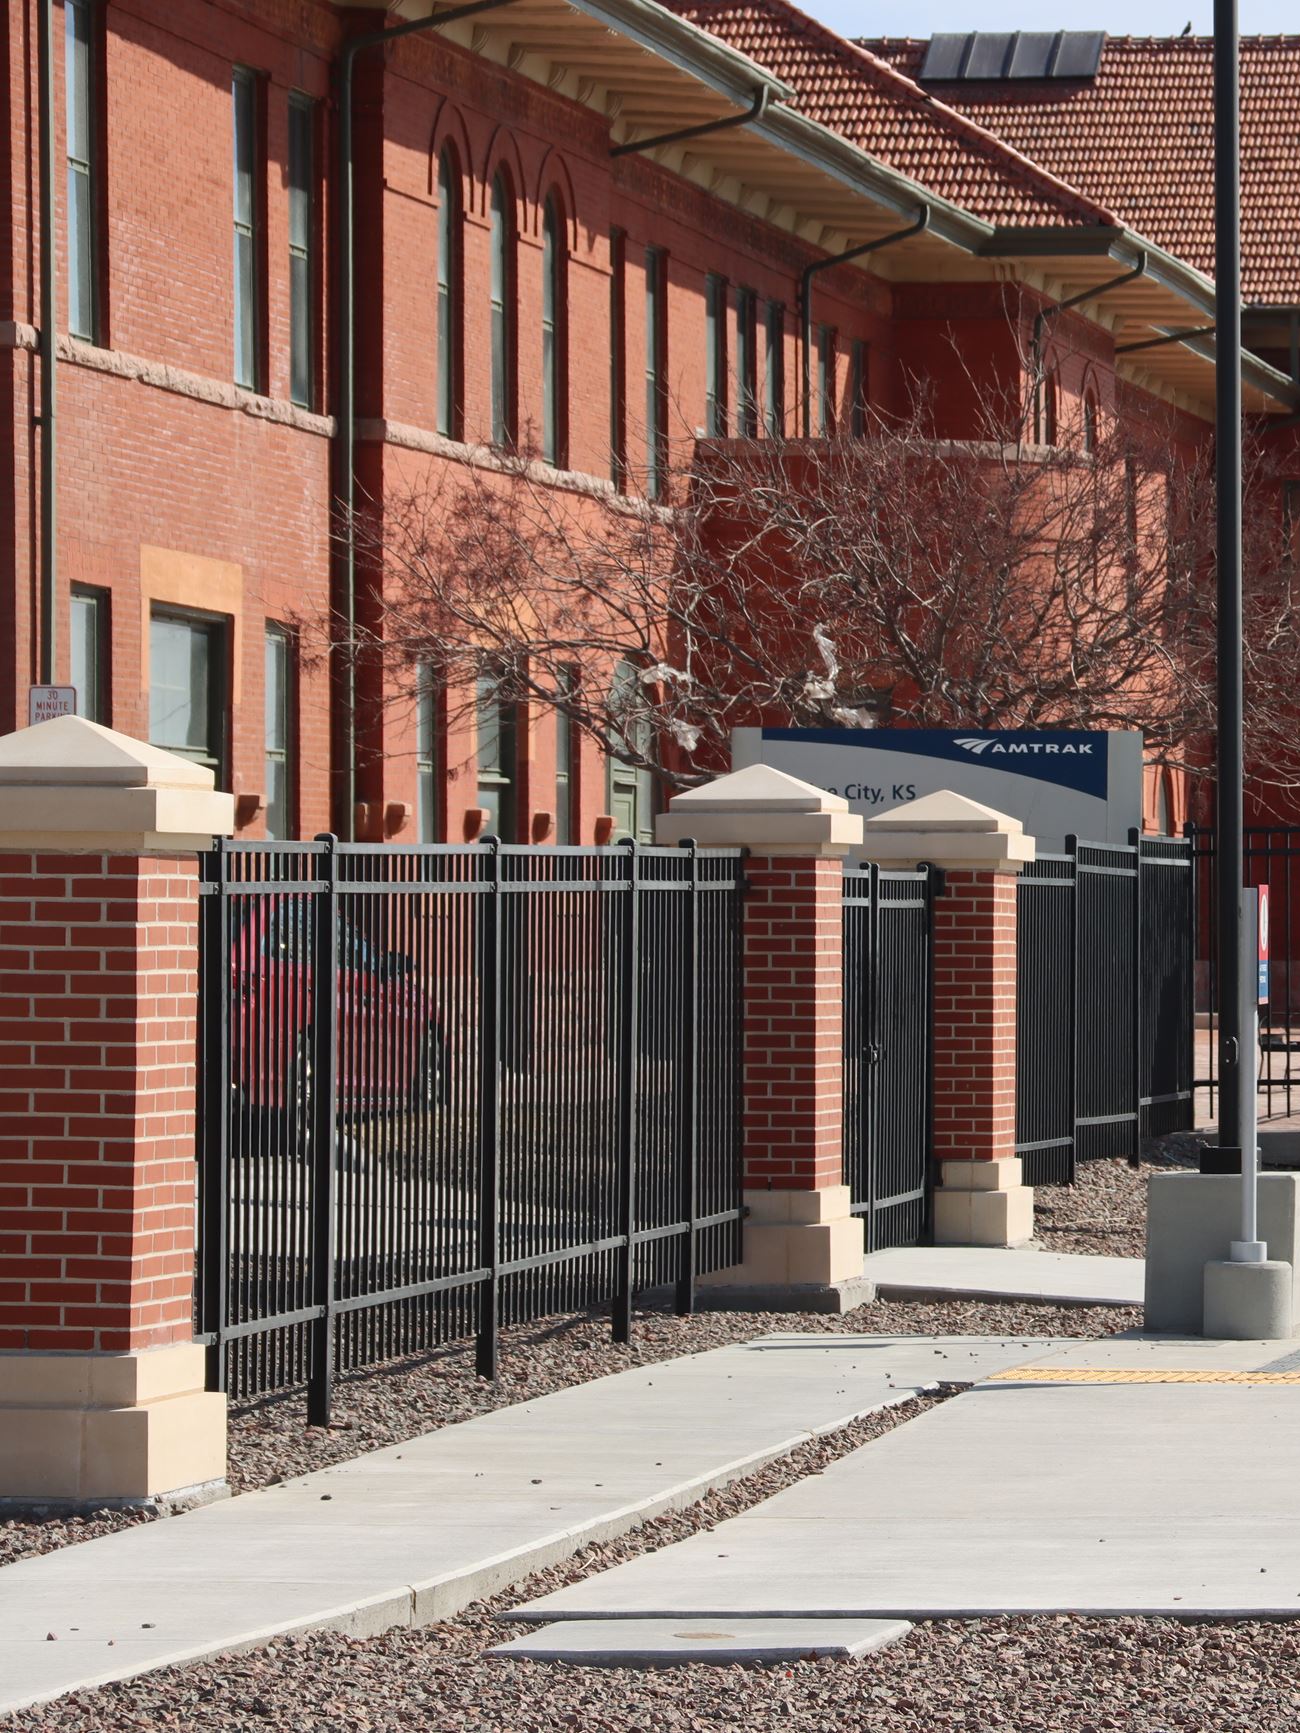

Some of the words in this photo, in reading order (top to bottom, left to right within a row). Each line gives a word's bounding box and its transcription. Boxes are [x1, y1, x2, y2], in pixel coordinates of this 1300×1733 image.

[47, 690, 58, 700] 30
[36, 701, 68, 711] MINUTE
[991, 743, 1093, 754] AMTRAK
[844, 783, 885, 804] City,
[892, 784, 916, 800] KS
